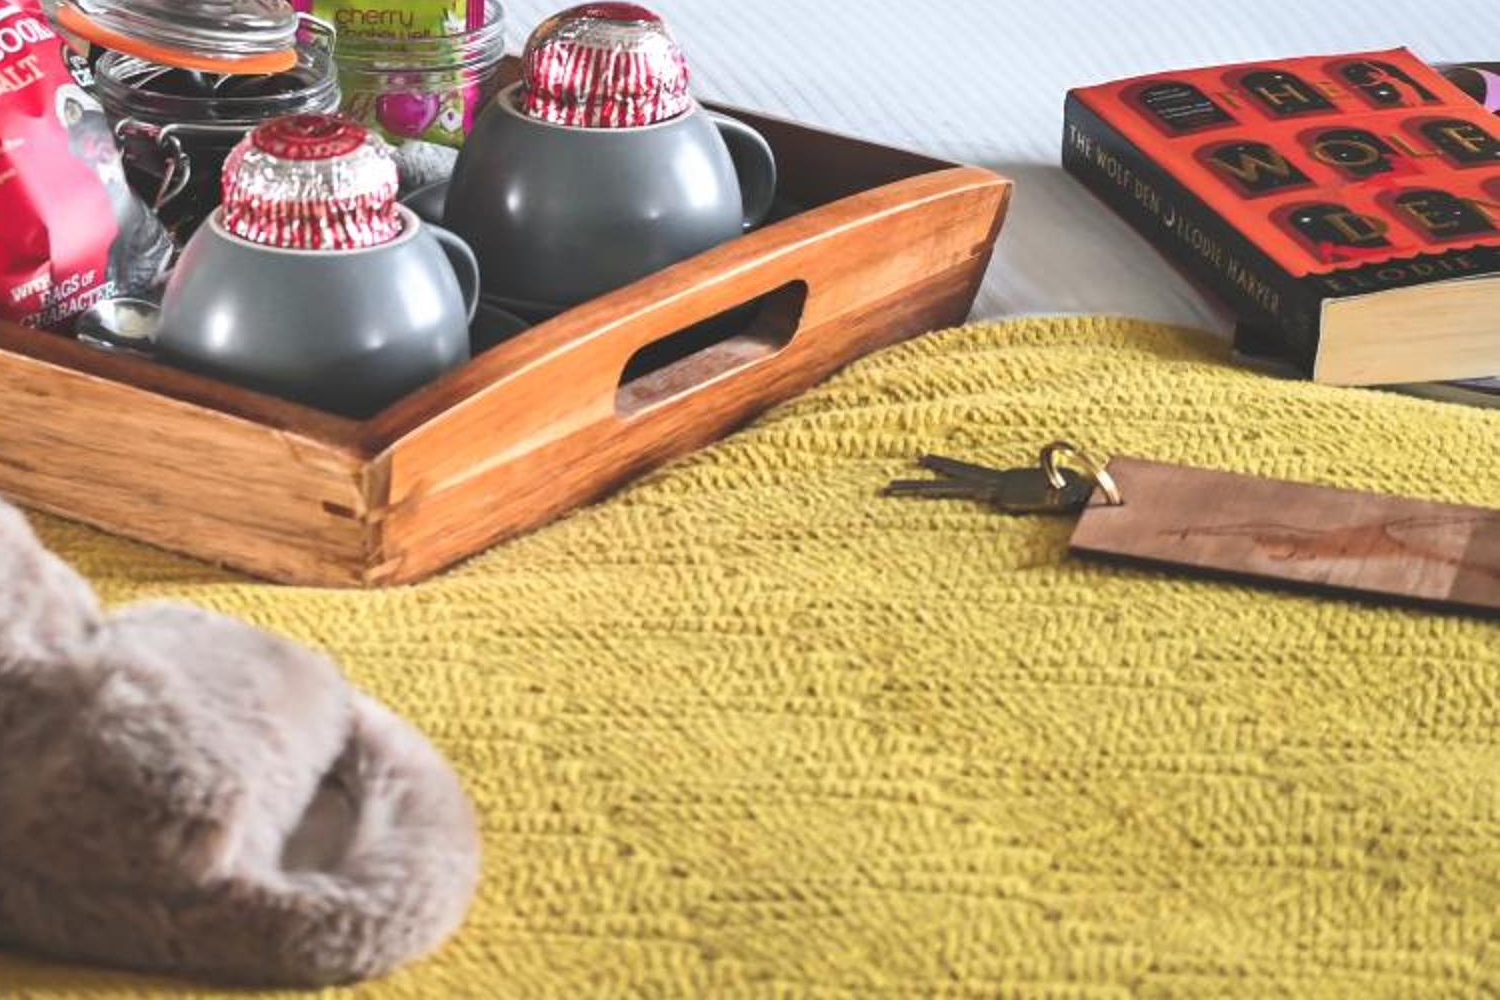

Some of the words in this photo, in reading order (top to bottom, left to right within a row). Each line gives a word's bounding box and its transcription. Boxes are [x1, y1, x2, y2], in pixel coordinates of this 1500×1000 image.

[335, 6, 414, 28] cherry
[1069, 124, 1092, 159] THE
[1096, 148, 1131, 188] WOLF
[1211, 126, 1487, 182] WOLF
